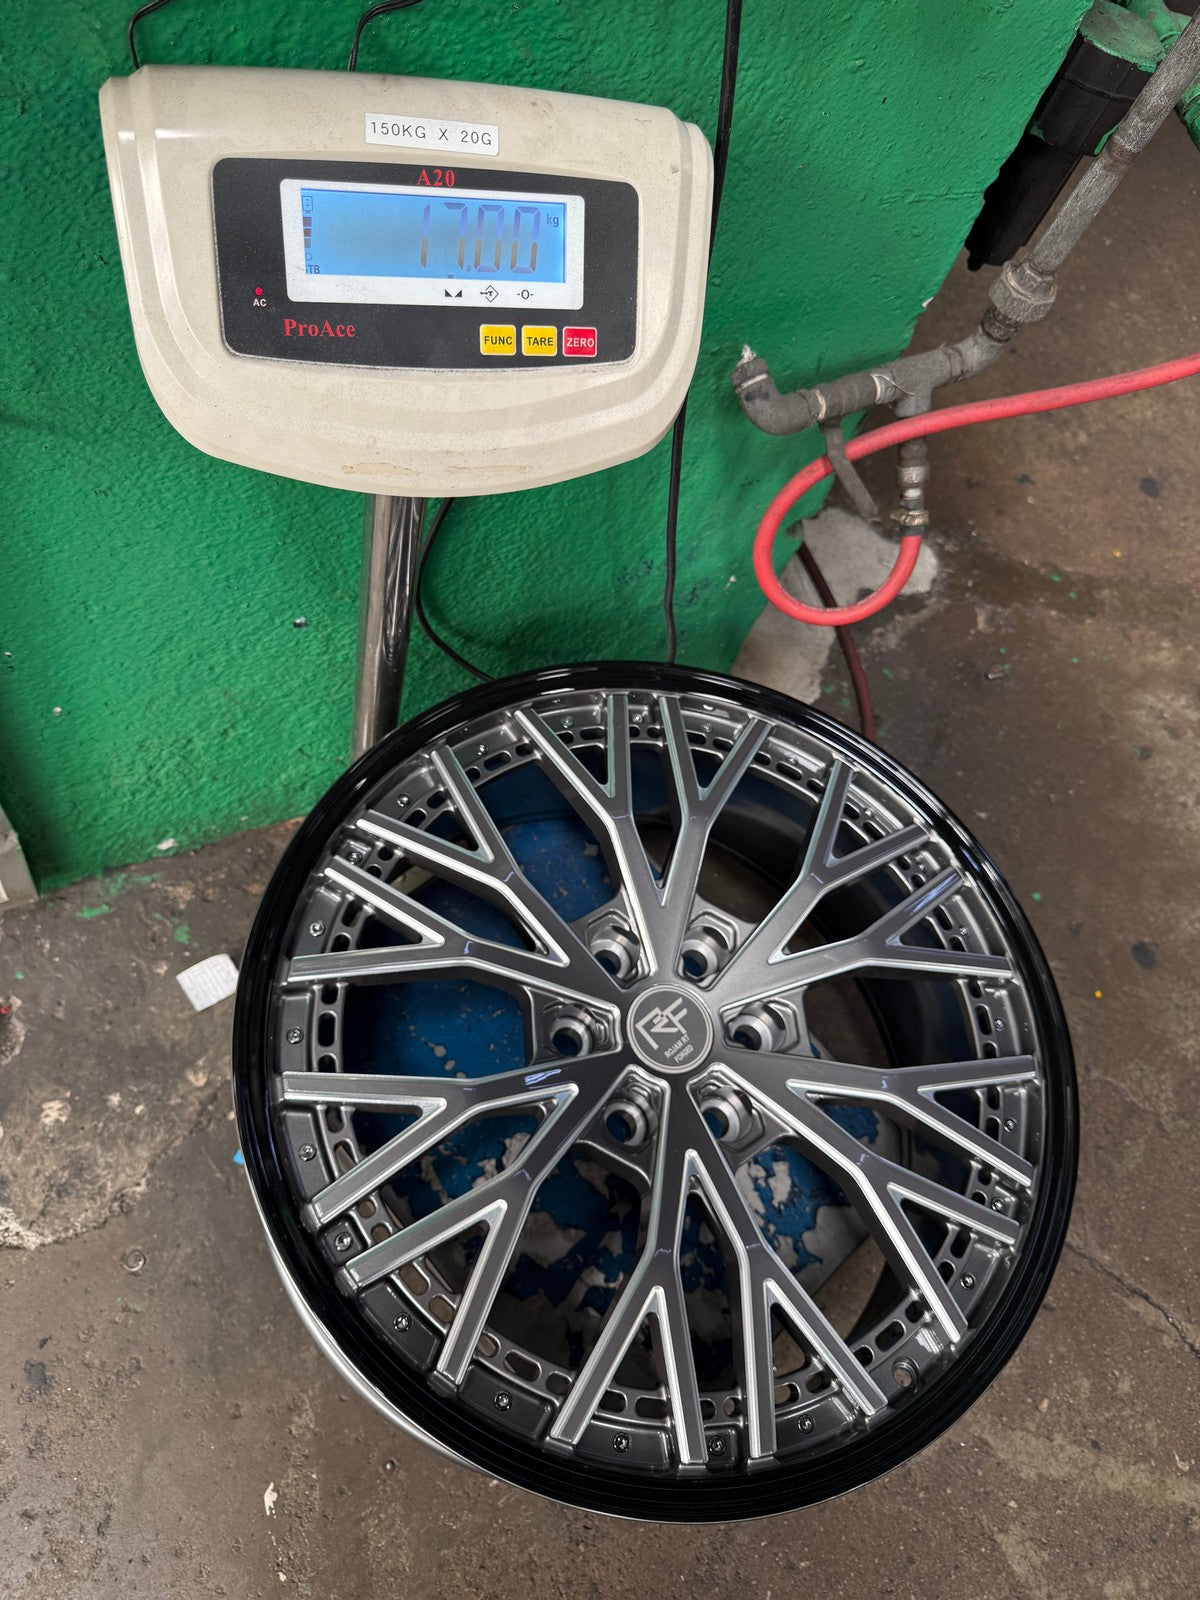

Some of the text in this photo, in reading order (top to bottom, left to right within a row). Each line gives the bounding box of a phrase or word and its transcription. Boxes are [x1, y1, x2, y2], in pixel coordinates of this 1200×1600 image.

[370, 121, 492, 146] 150KG X 20G
[416, 168, 456, 188] A20
[420, 202, 559, 274] 17.00 kg
[252, 298, 267, 307] AC
[283, 318, 357, 338] ProAce
[484, 335, 513, 345] FUNC
[526, 336, 554, 346] TARE
[566, 337, 595, 348] ZERO
